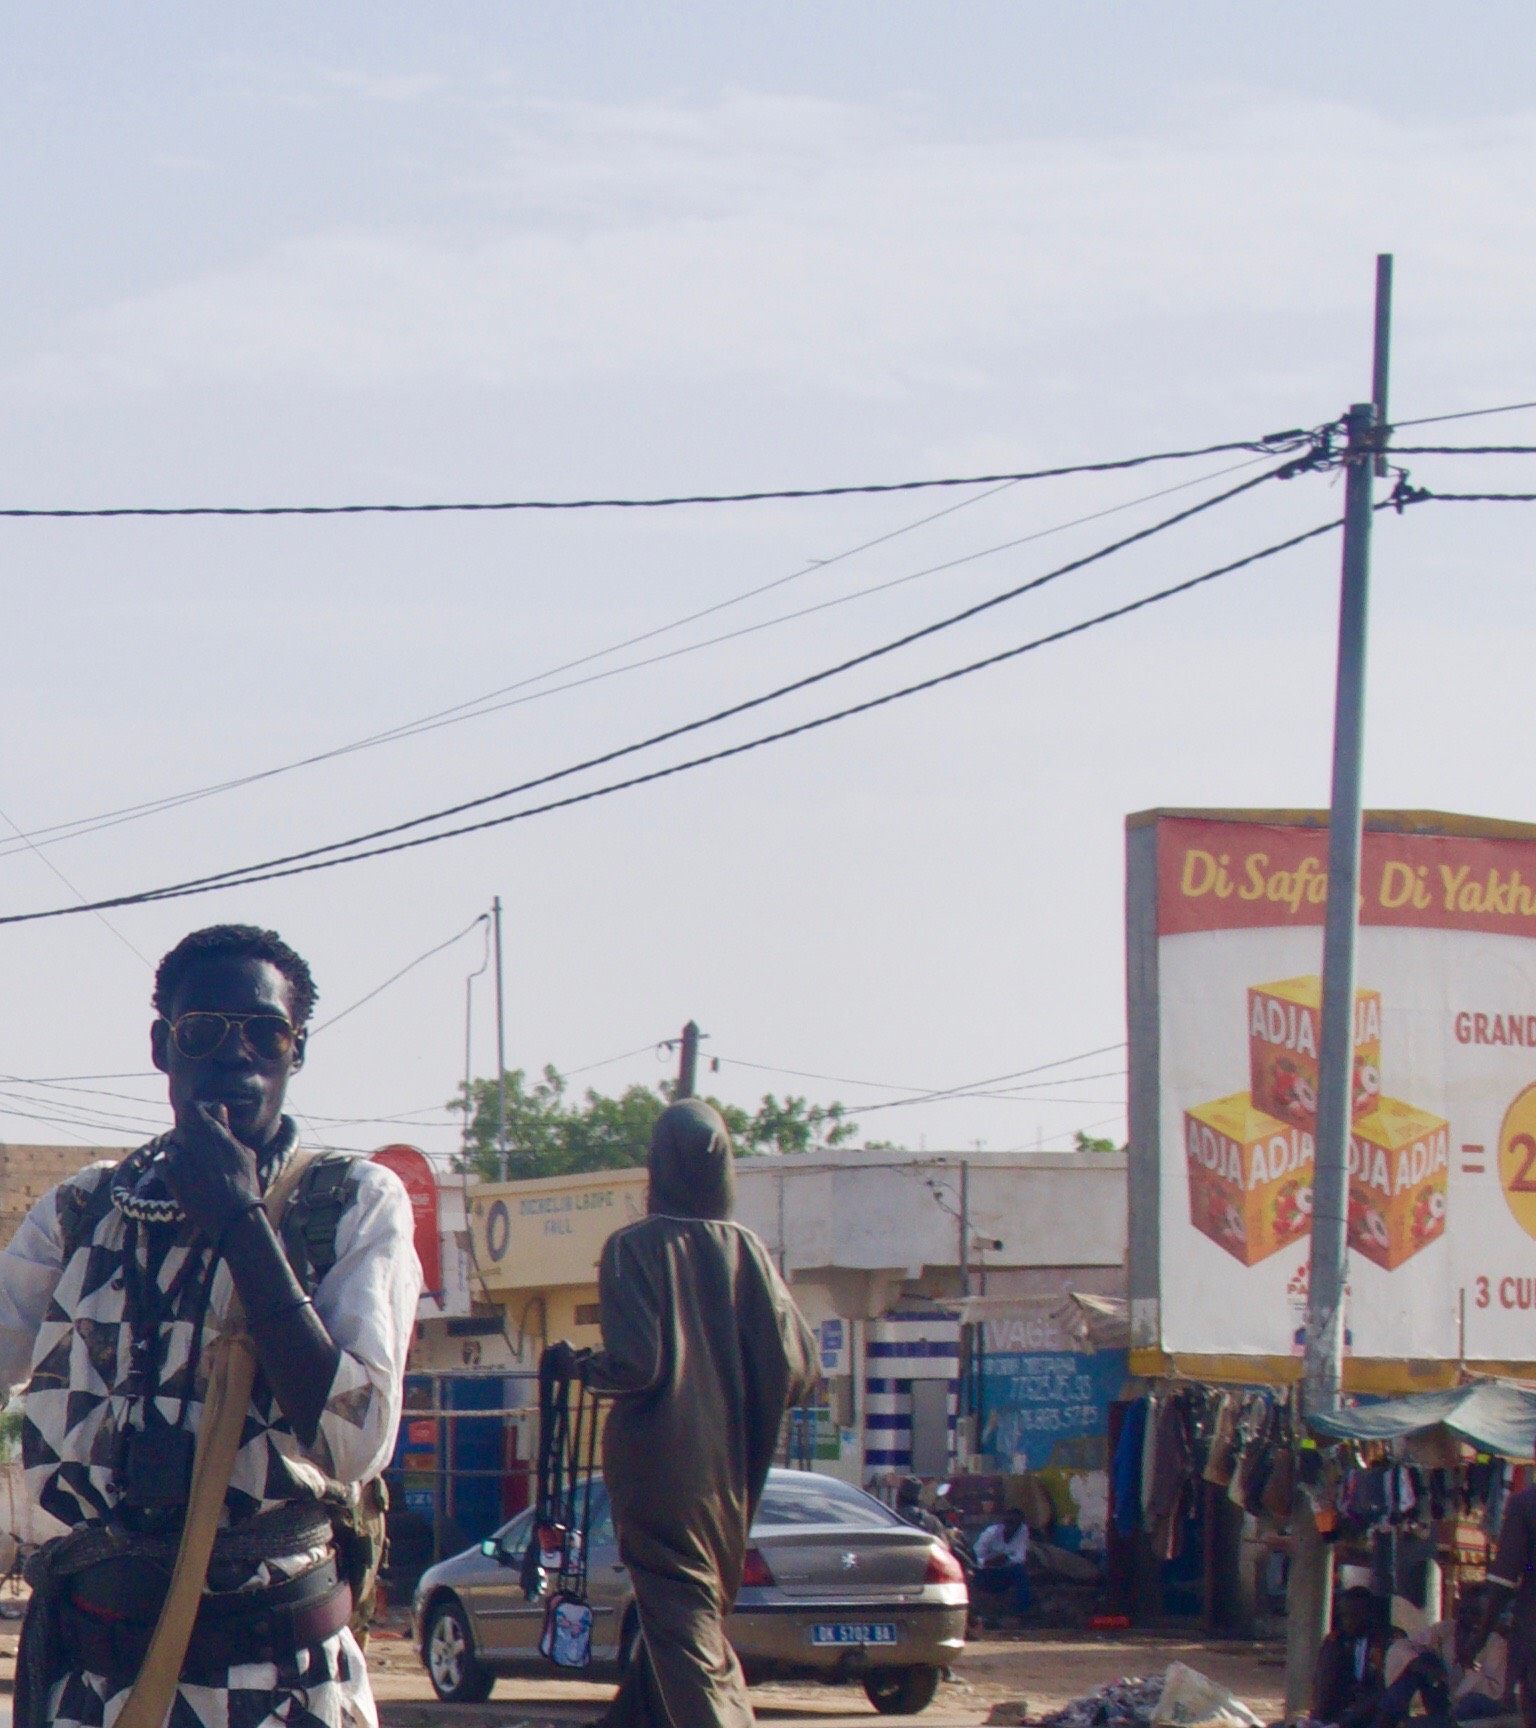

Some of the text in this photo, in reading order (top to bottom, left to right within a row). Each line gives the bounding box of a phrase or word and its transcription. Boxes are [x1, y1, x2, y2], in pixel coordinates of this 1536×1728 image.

[1180, 849, 1536, 916] Di Safa Di Yakh
[1249, 995, 1318, 1059] ADJA
[1187, 1119, 1245, 1190] ADJA
[1394, 1130, 1449, 1197] ADJA
[1475, 1275, 1536, 1310] 3 CU
